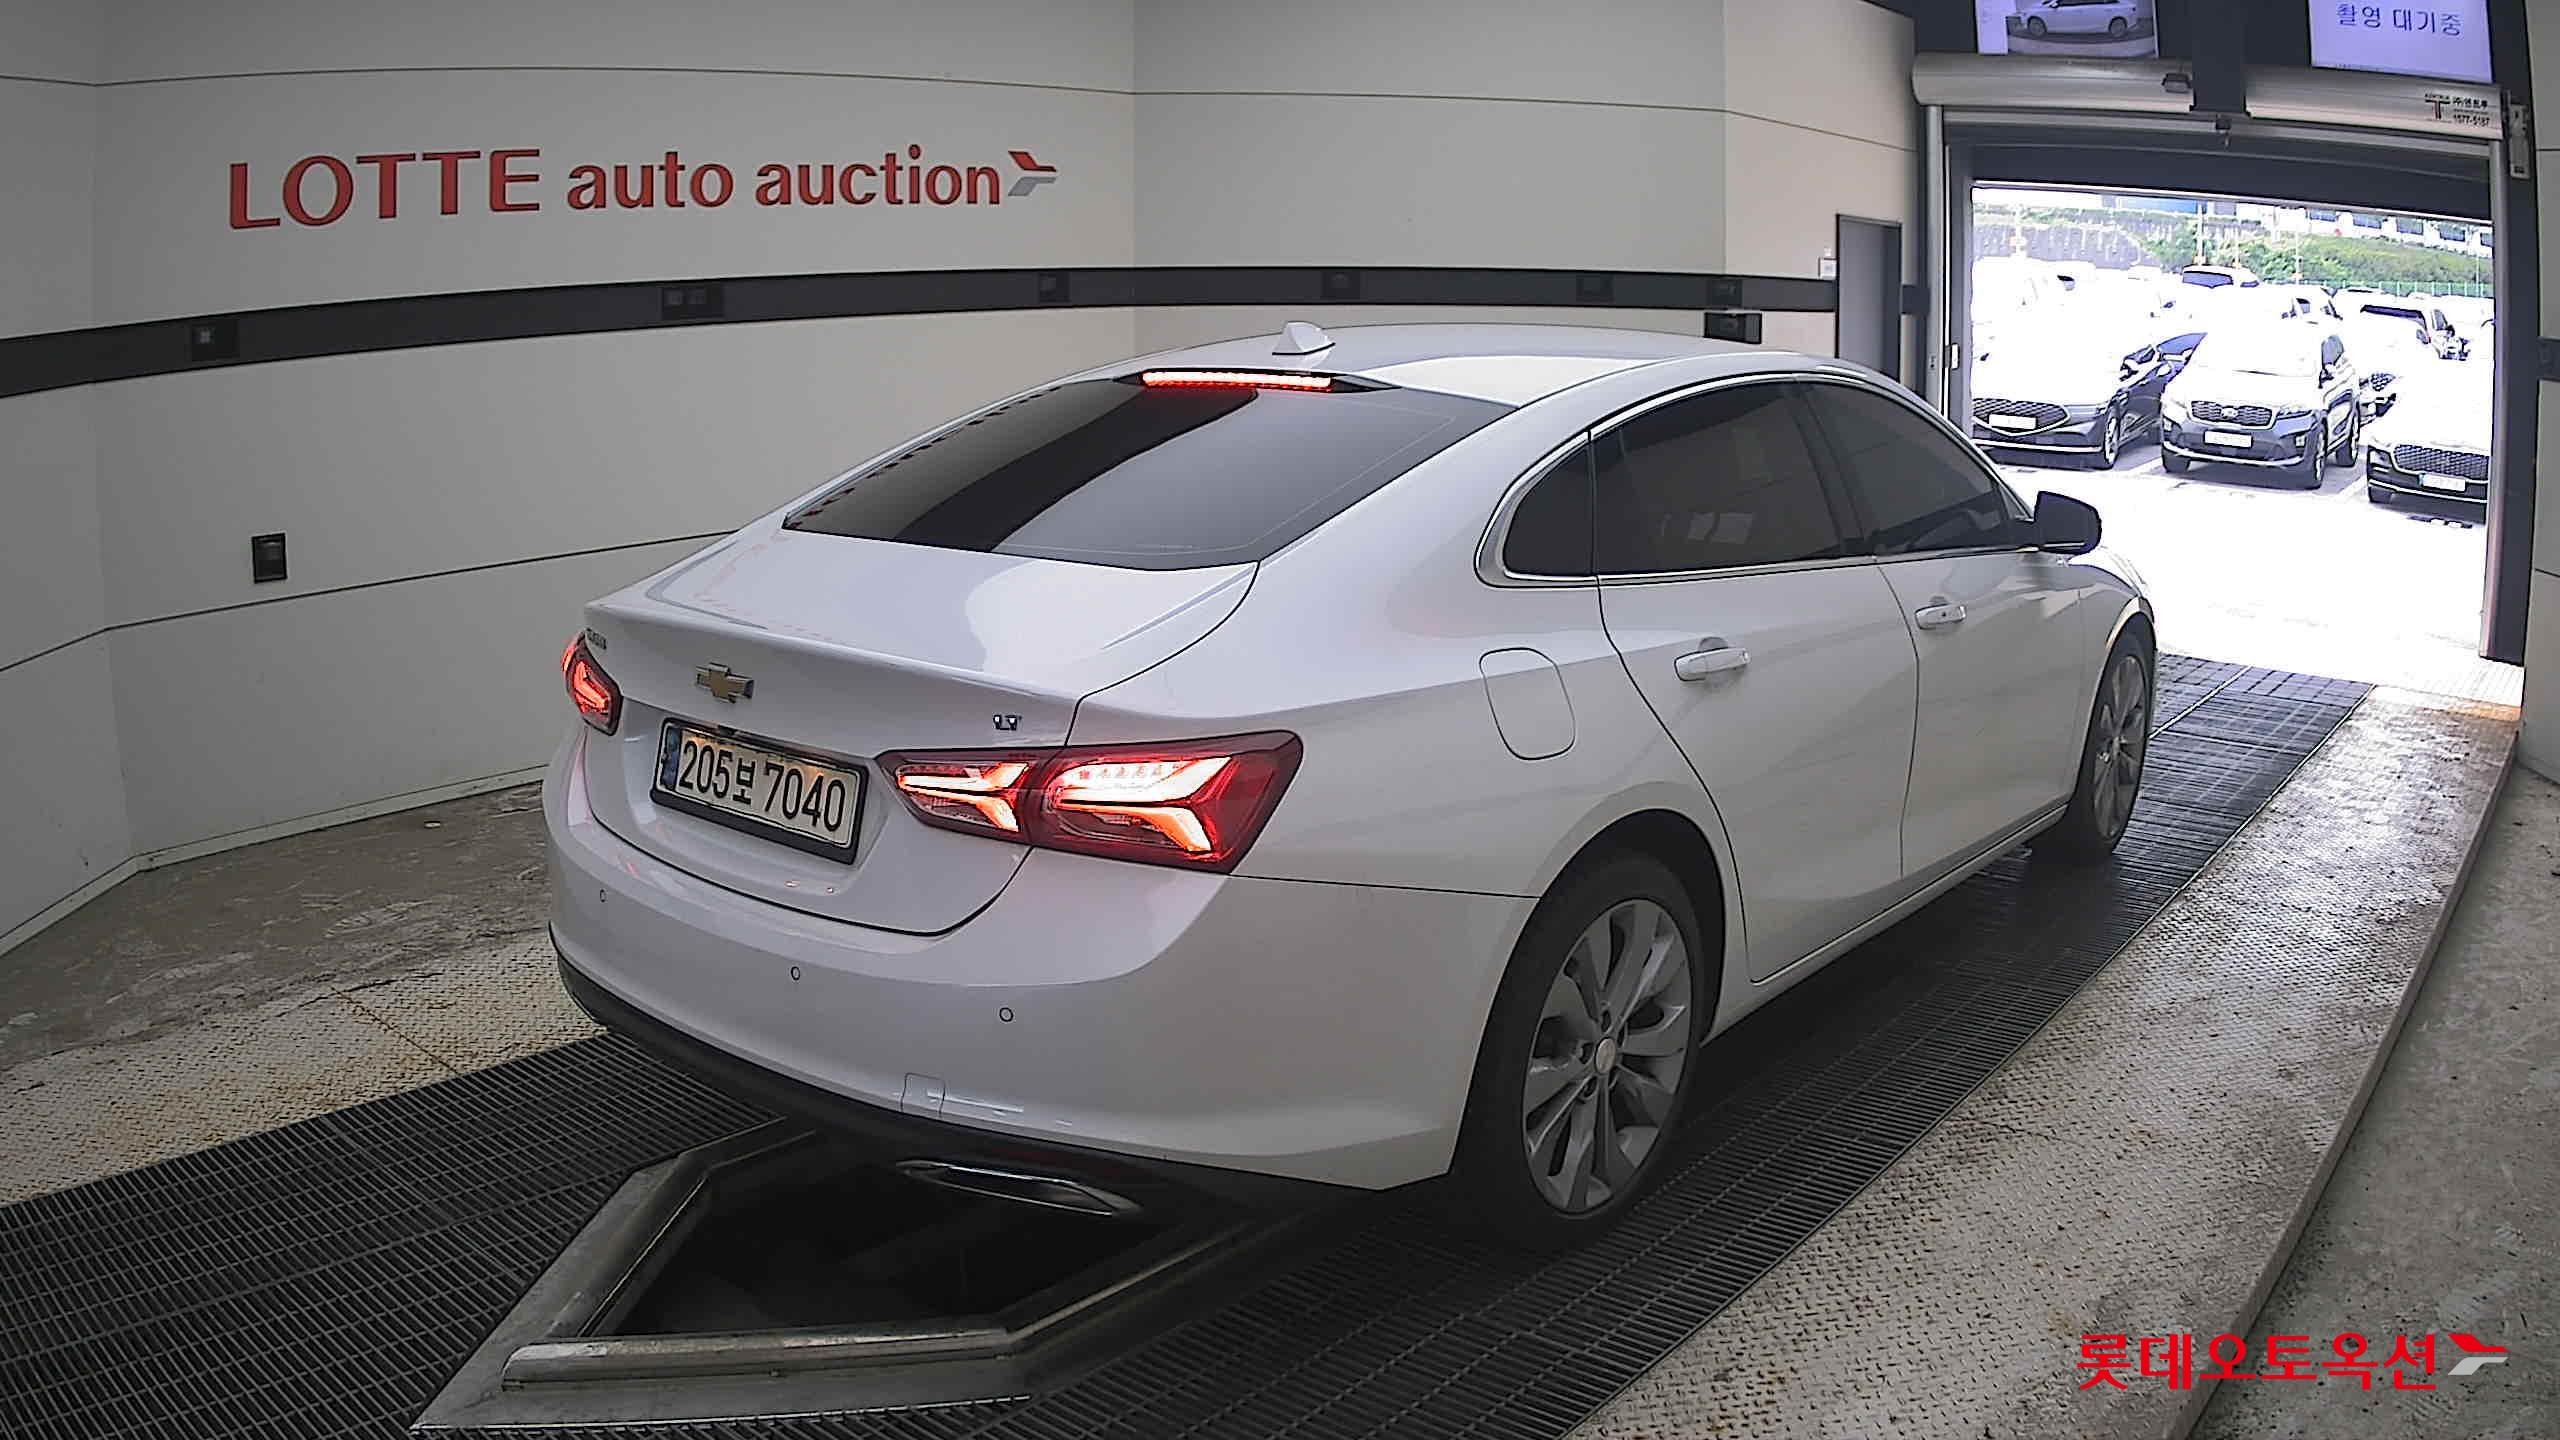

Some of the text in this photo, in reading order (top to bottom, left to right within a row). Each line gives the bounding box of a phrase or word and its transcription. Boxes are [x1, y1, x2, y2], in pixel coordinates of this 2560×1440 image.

[2336, 3, 2462, 37] 촬영 대기중
[229, 143, 1002, 230] LOTTE auto auction
[763, 760, 847, 833] 7040
